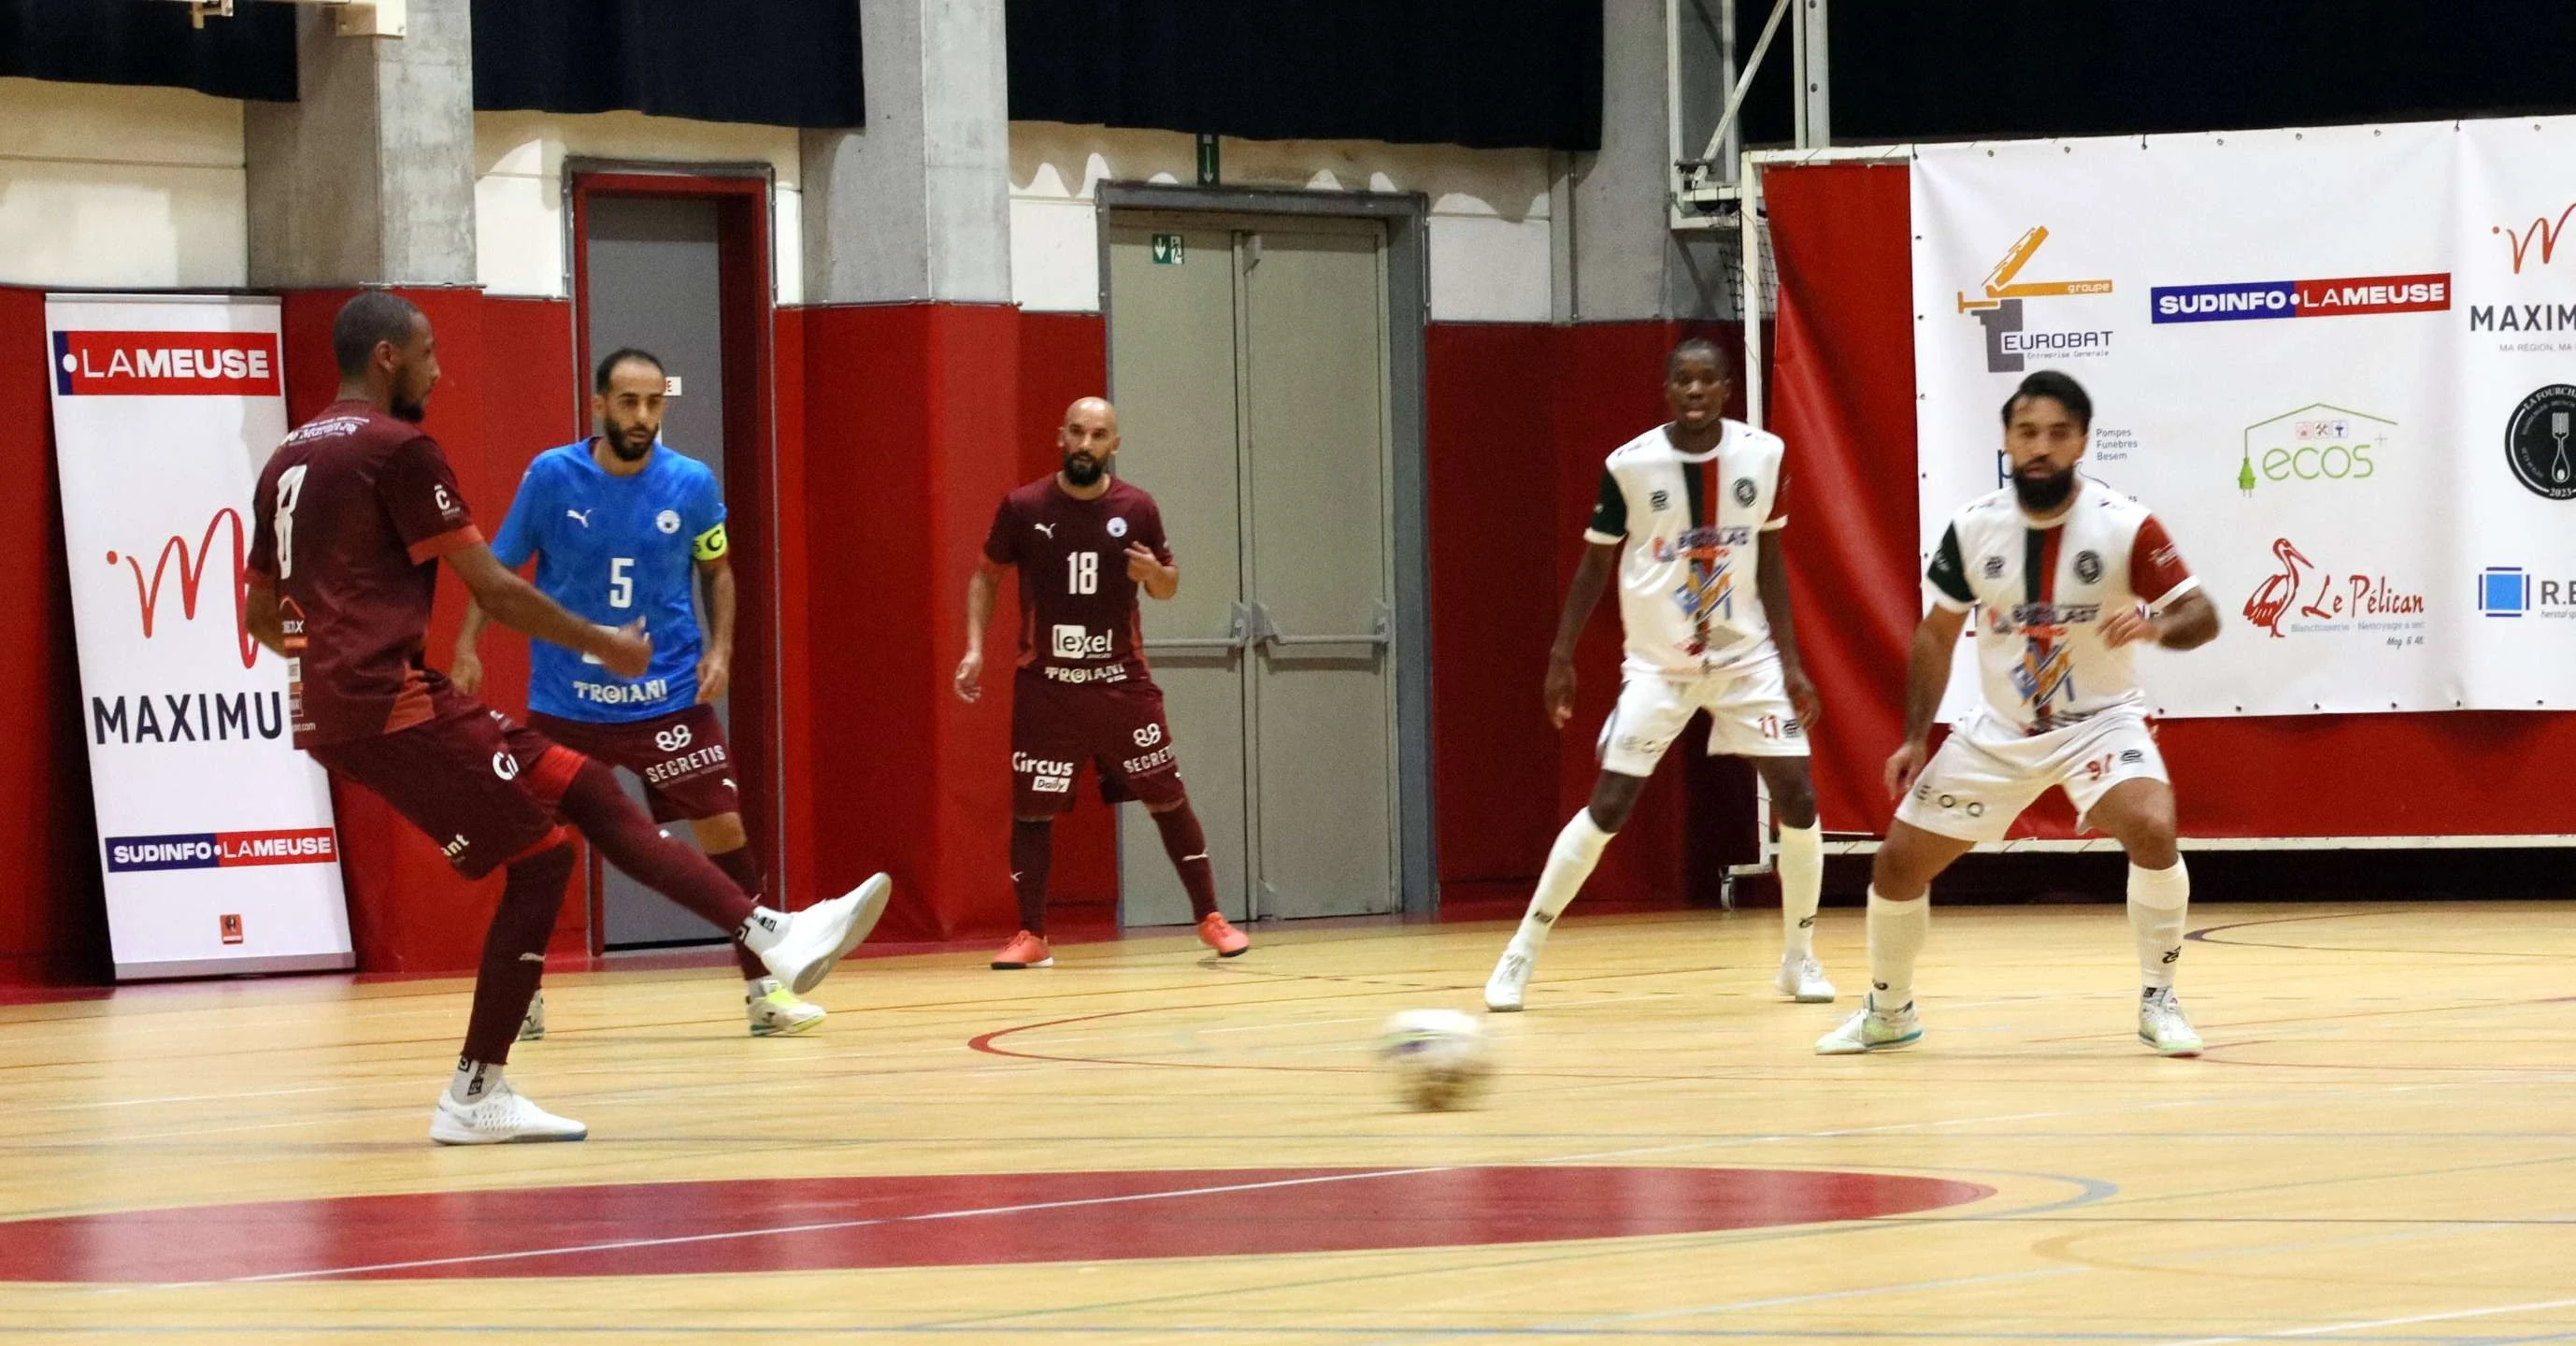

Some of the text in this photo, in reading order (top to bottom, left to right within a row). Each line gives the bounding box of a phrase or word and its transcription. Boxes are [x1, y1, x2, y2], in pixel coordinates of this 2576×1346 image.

[2068, 282, 2110, 294] groupe
[2470, 304, 2576, 332] MAXIM
[2004, 331, 2113, 351] EUROBAT
[2536, 387, 2576, 402] FOURCH
[2097, 428, 2132, 439] Pompes
[2263, 444, 2374, 480] ecos
[609, 557, 636, 609] 5
[1066, 551, 1099, 594] 18
[2301, 574, 2425, 620] Le Pélican
[1055, 628, 1113, 653] lexel
[93, 691, 283, 745] MAXIMU
[645, 745, 726, 783] SECRETIS
[1011, 751, 1074, 777] Circus
[1038, 779, 1066, 793] Daily
